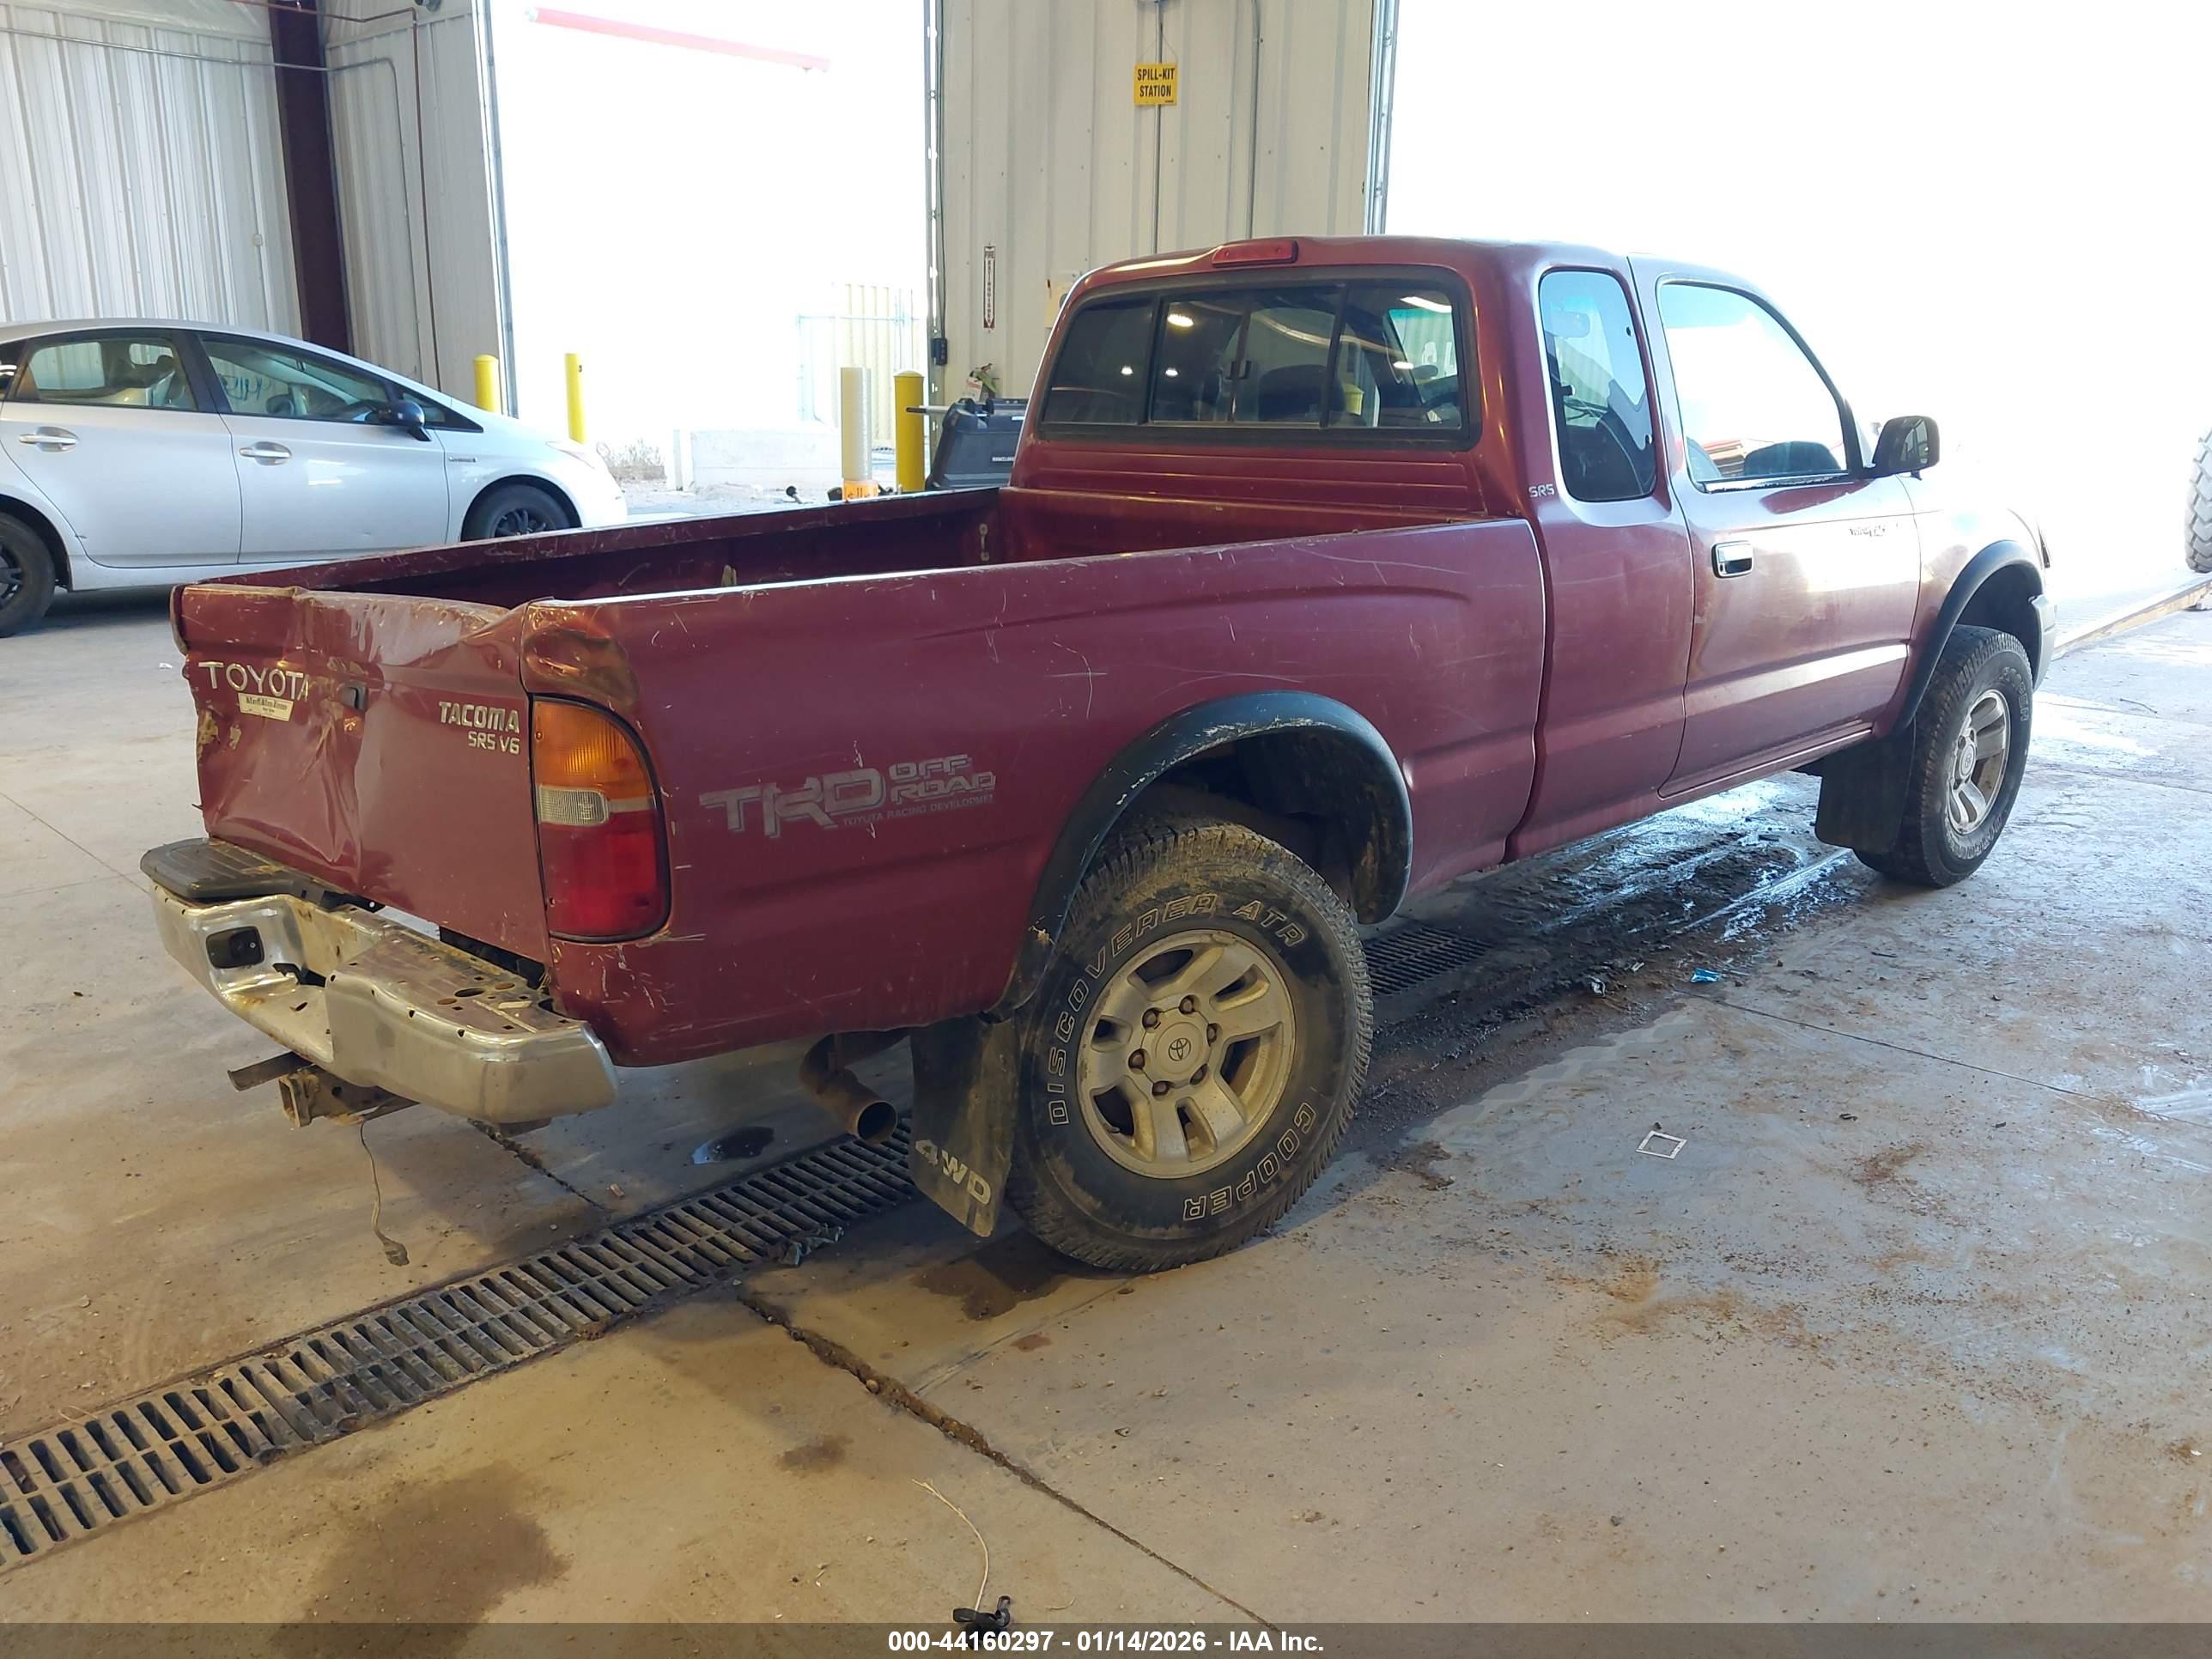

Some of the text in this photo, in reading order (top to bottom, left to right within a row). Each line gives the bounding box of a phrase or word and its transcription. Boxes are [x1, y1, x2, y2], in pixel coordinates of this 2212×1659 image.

[1137, 68, 1175, 81] SPILL-KIT
[1139, 84, 1171, 97] STATION
[1528, 483, 1555, 498] SR5
[198, 660, 311, 701] TOYOTA
[438, 701, 521, 733] TACOMA
[467, 731, 521, 755] SR5 V6
[889, 753, 973, 781] OFF
[699, 767, 887, 839] TRD
[890, 771, 997, 805] ROAD
[842, 812, 883, 826] TOYOTA
[887, 805, 927, 821] RACING
[1048, 893, 1309, 1126] DISCOVERER ATR
[915, 1139, 992, 1206] 4WD
[1182, 1100, 1318, 1222] COOPER
